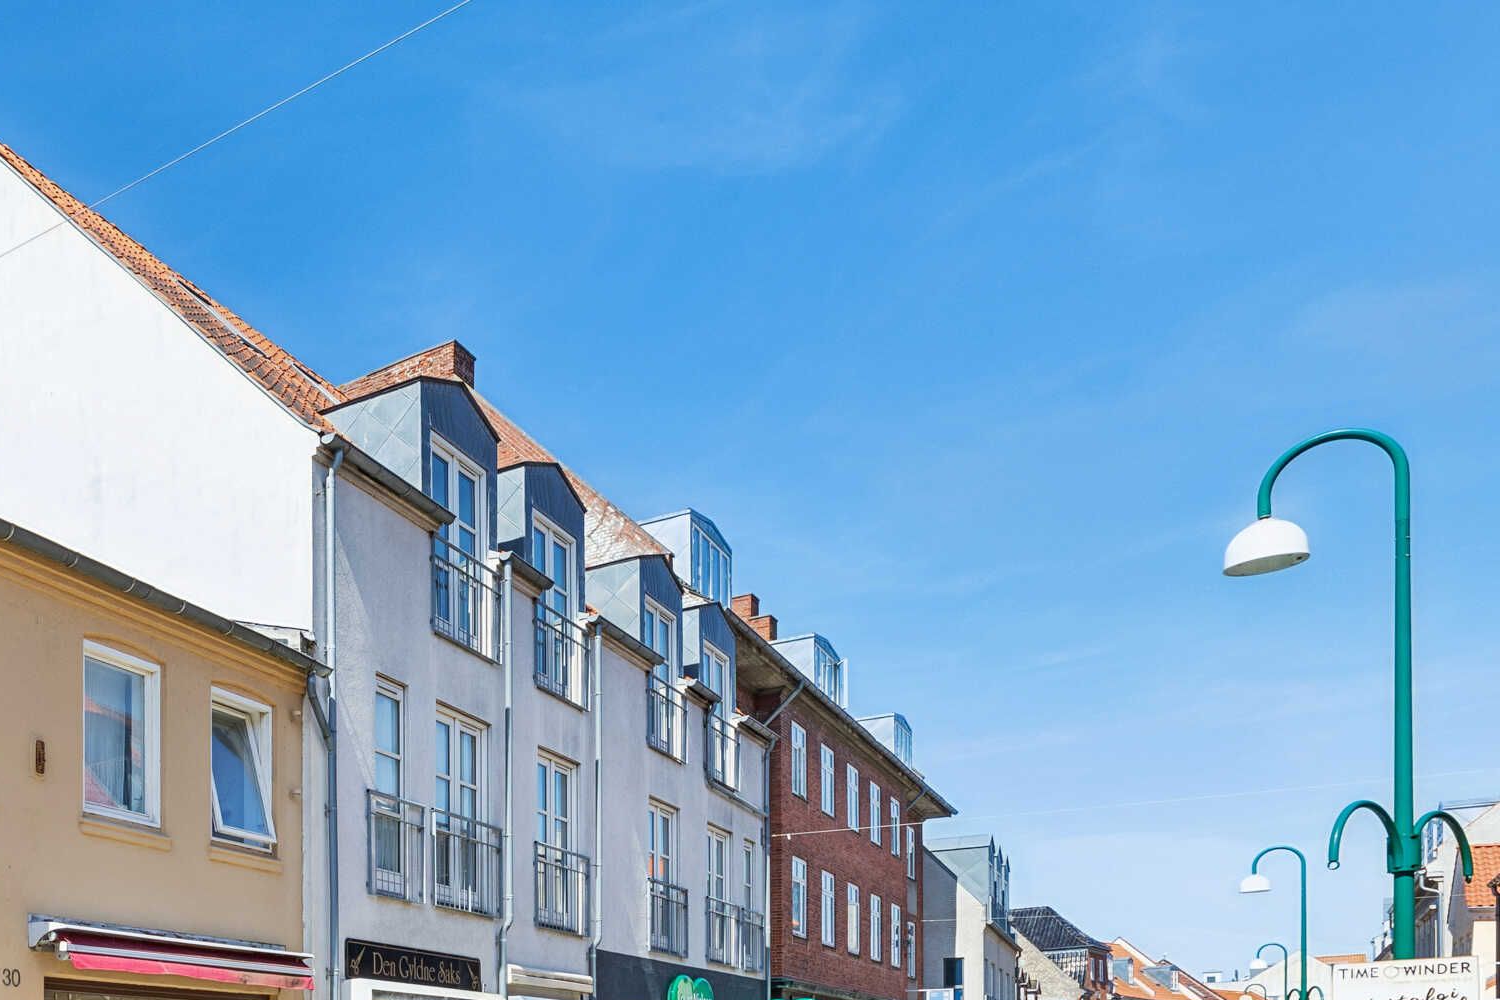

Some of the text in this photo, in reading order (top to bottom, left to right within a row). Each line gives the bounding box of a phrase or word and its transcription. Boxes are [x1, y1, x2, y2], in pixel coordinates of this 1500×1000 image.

[2, 968, 21, 987] 30
[372, 951, 461, 985] Den Gyldne Saks
[1338, 966, 1380, 980] TIME
[1403, 961, 1472, 977] WINDER
